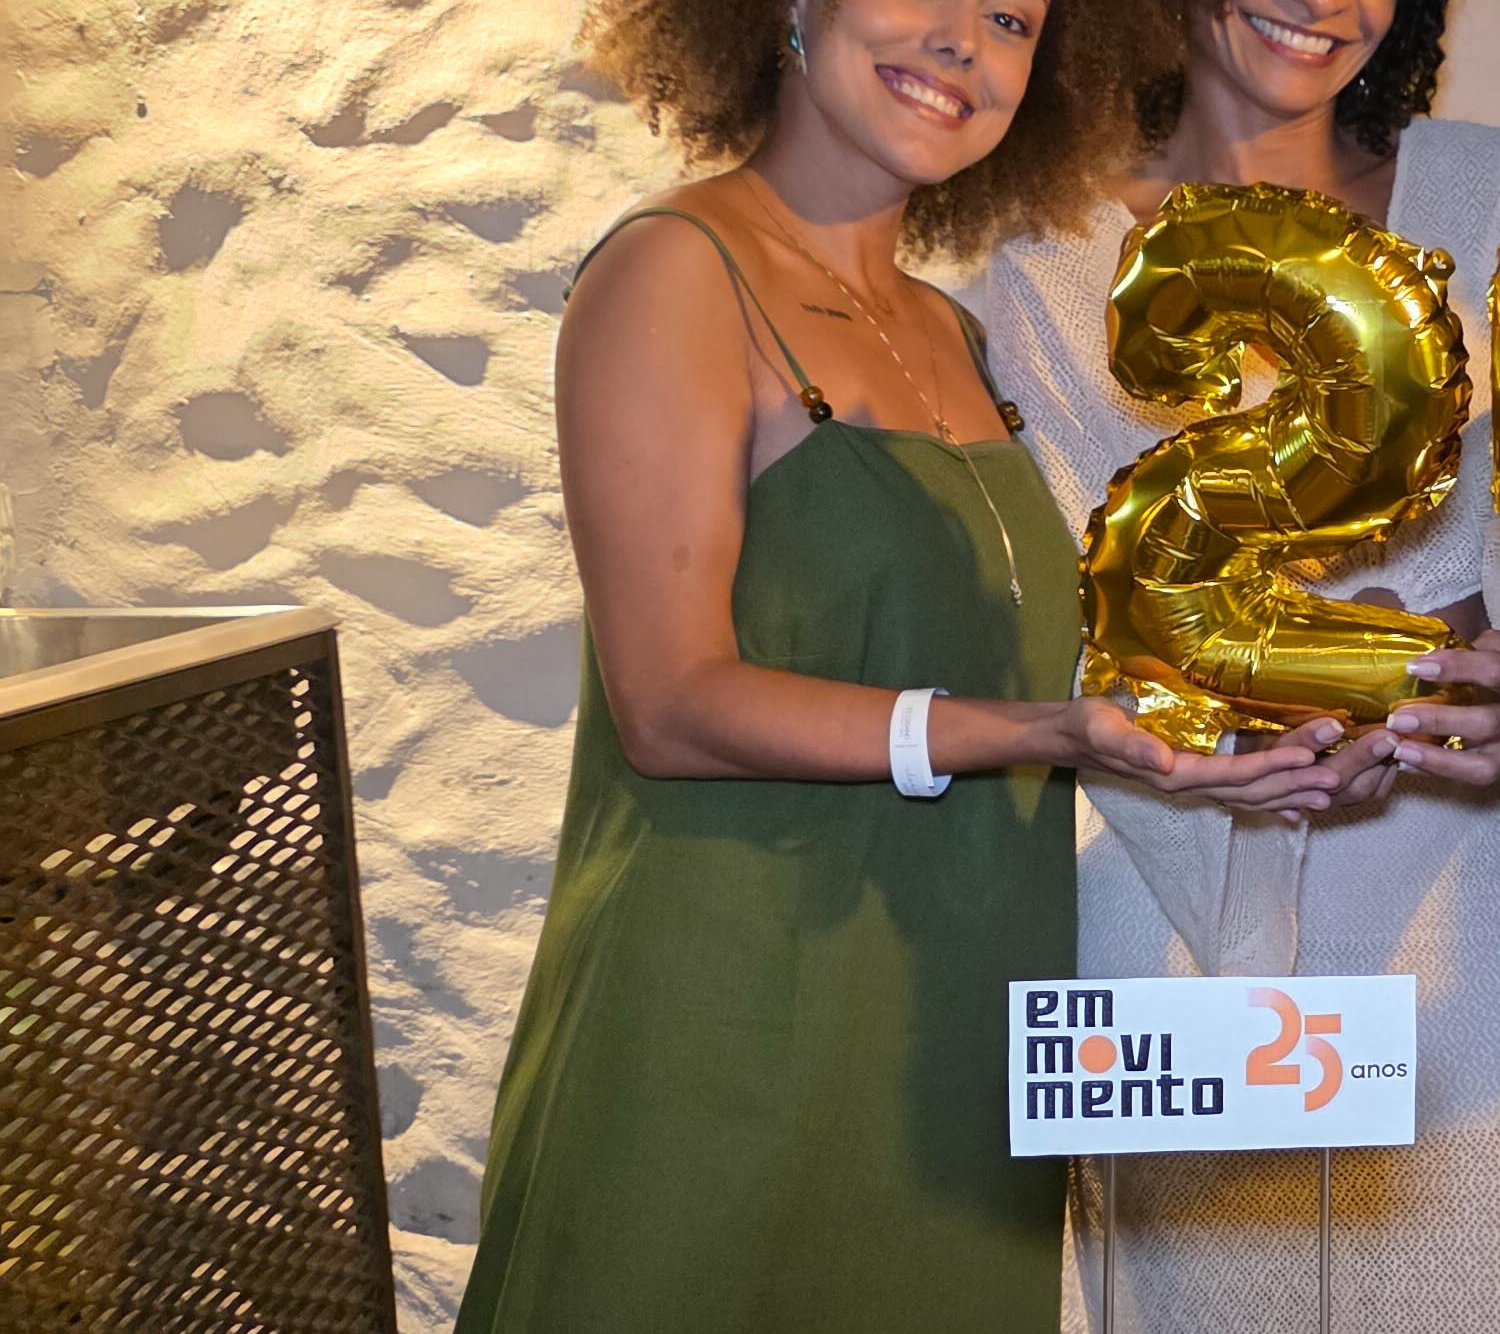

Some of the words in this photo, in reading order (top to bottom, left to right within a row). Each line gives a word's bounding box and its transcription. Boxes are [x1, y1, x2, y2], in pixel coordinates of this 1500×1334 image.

[1026, 989, 1113, 1028] em
[1245, 987, 1342, 1112] 25
[1351, 1062, 1407, 1078] anos
[1026, 1074, 1224, 1119] mento
